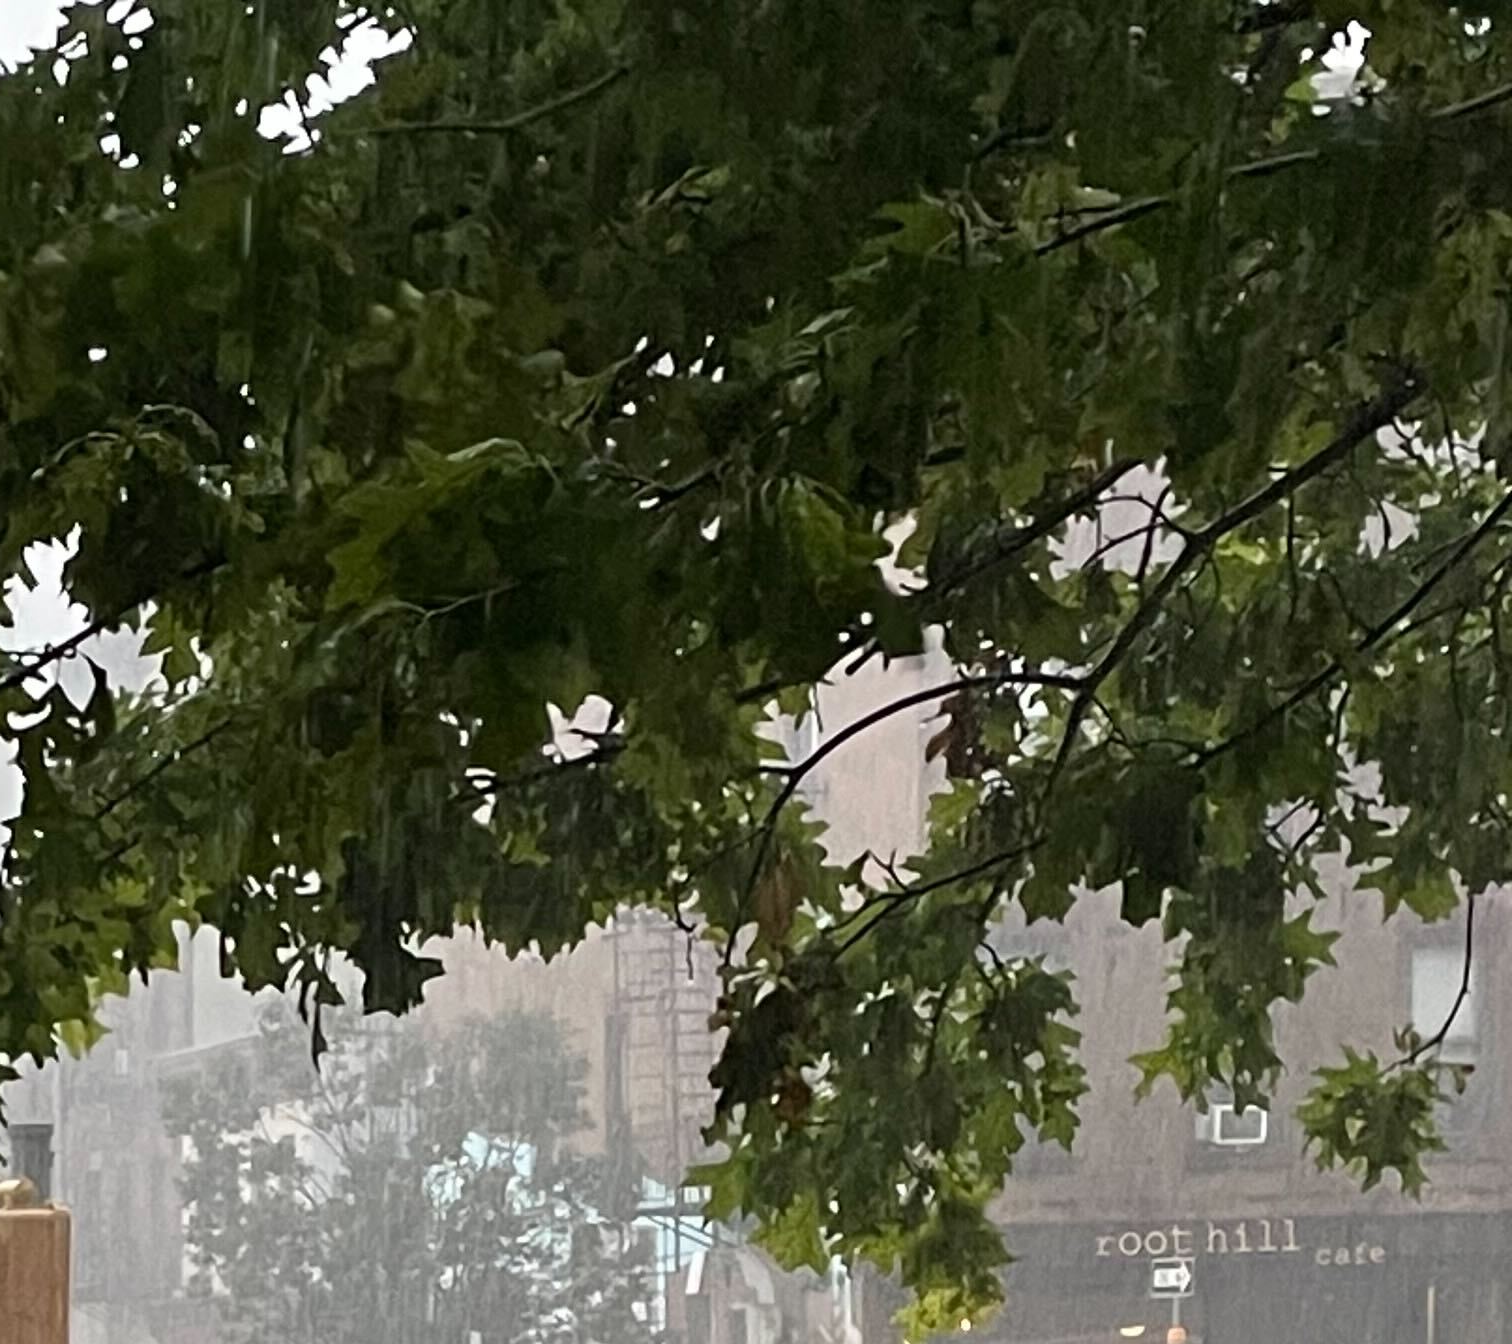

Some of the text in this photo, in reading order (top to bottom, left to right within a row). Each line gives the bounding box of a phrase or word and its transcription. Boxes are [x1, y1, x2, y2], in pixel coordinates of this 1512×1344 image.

[1095, 1219, 1387, 1266] root hill cafe
